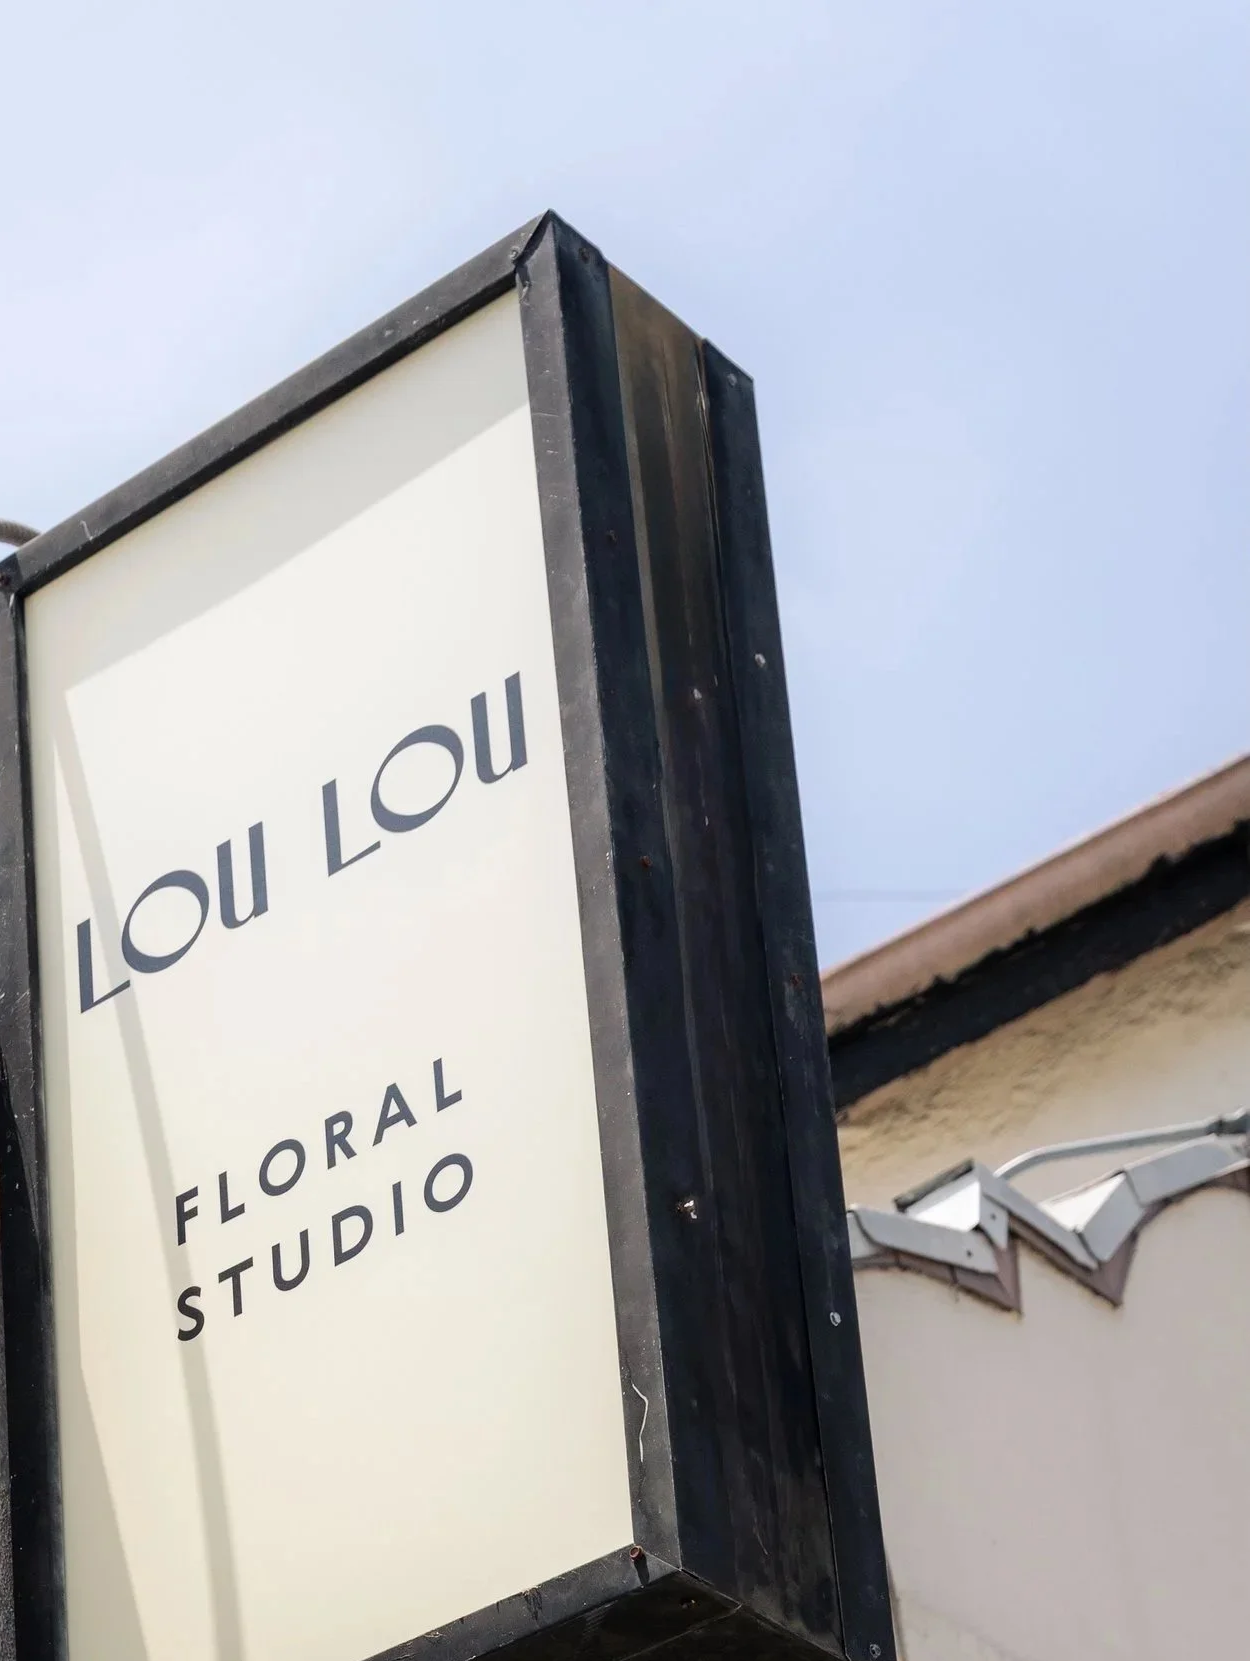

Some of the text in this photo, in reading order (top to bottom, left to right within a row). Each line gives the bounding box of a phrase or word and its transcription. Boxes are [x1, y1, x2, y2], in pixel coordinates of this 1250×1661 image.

[75, 671, 528, 1015] LOU LOU
[174, 1057, 464, 1248] FLORAL
[176, 1152, 475, 1343] STUDIO
